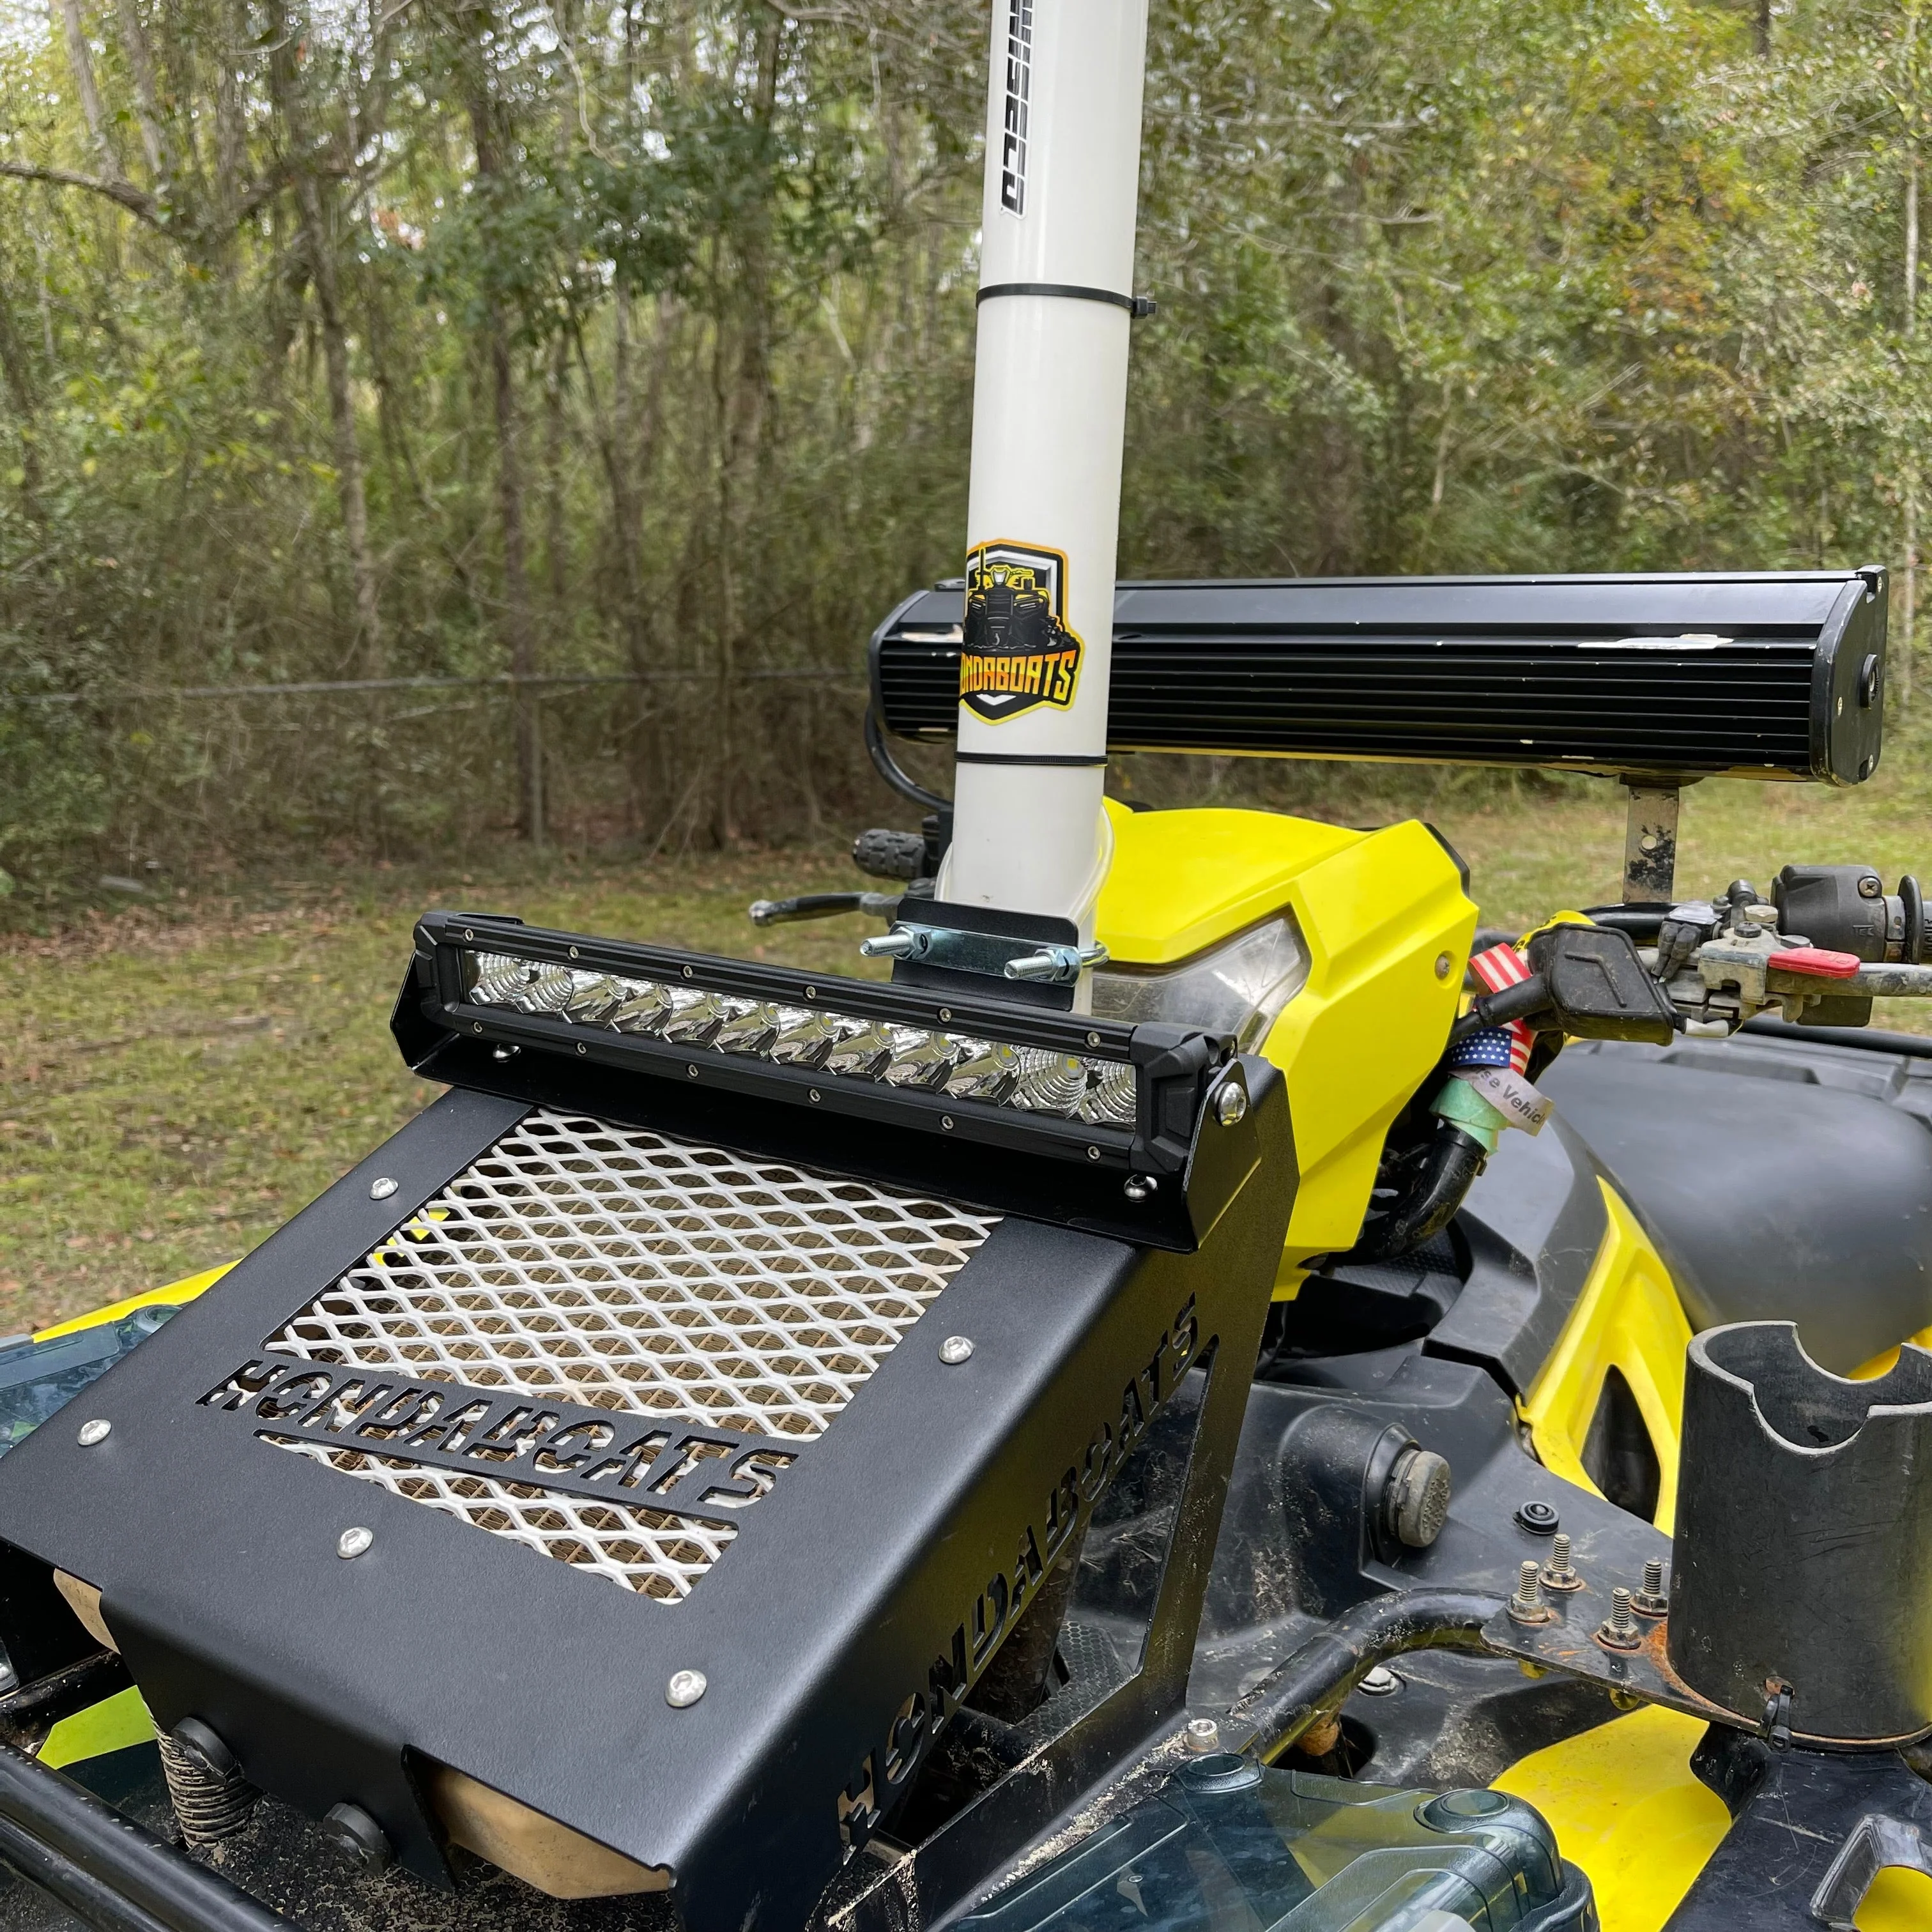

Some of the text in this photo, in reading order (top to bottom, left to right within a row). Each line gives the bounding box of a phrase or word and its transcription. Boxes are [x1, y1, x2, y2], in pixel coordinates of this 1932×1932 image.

[1001, 0, 1032, 215] WISECO
[960, 650, 1077, 701] ONDABOATS
[1503, 1084, 1546, 1124] Vehicl
[194, 1359, 799, 1508] HONDABOATS
[838, 1291, 1198, 1866] HONDABOATS
